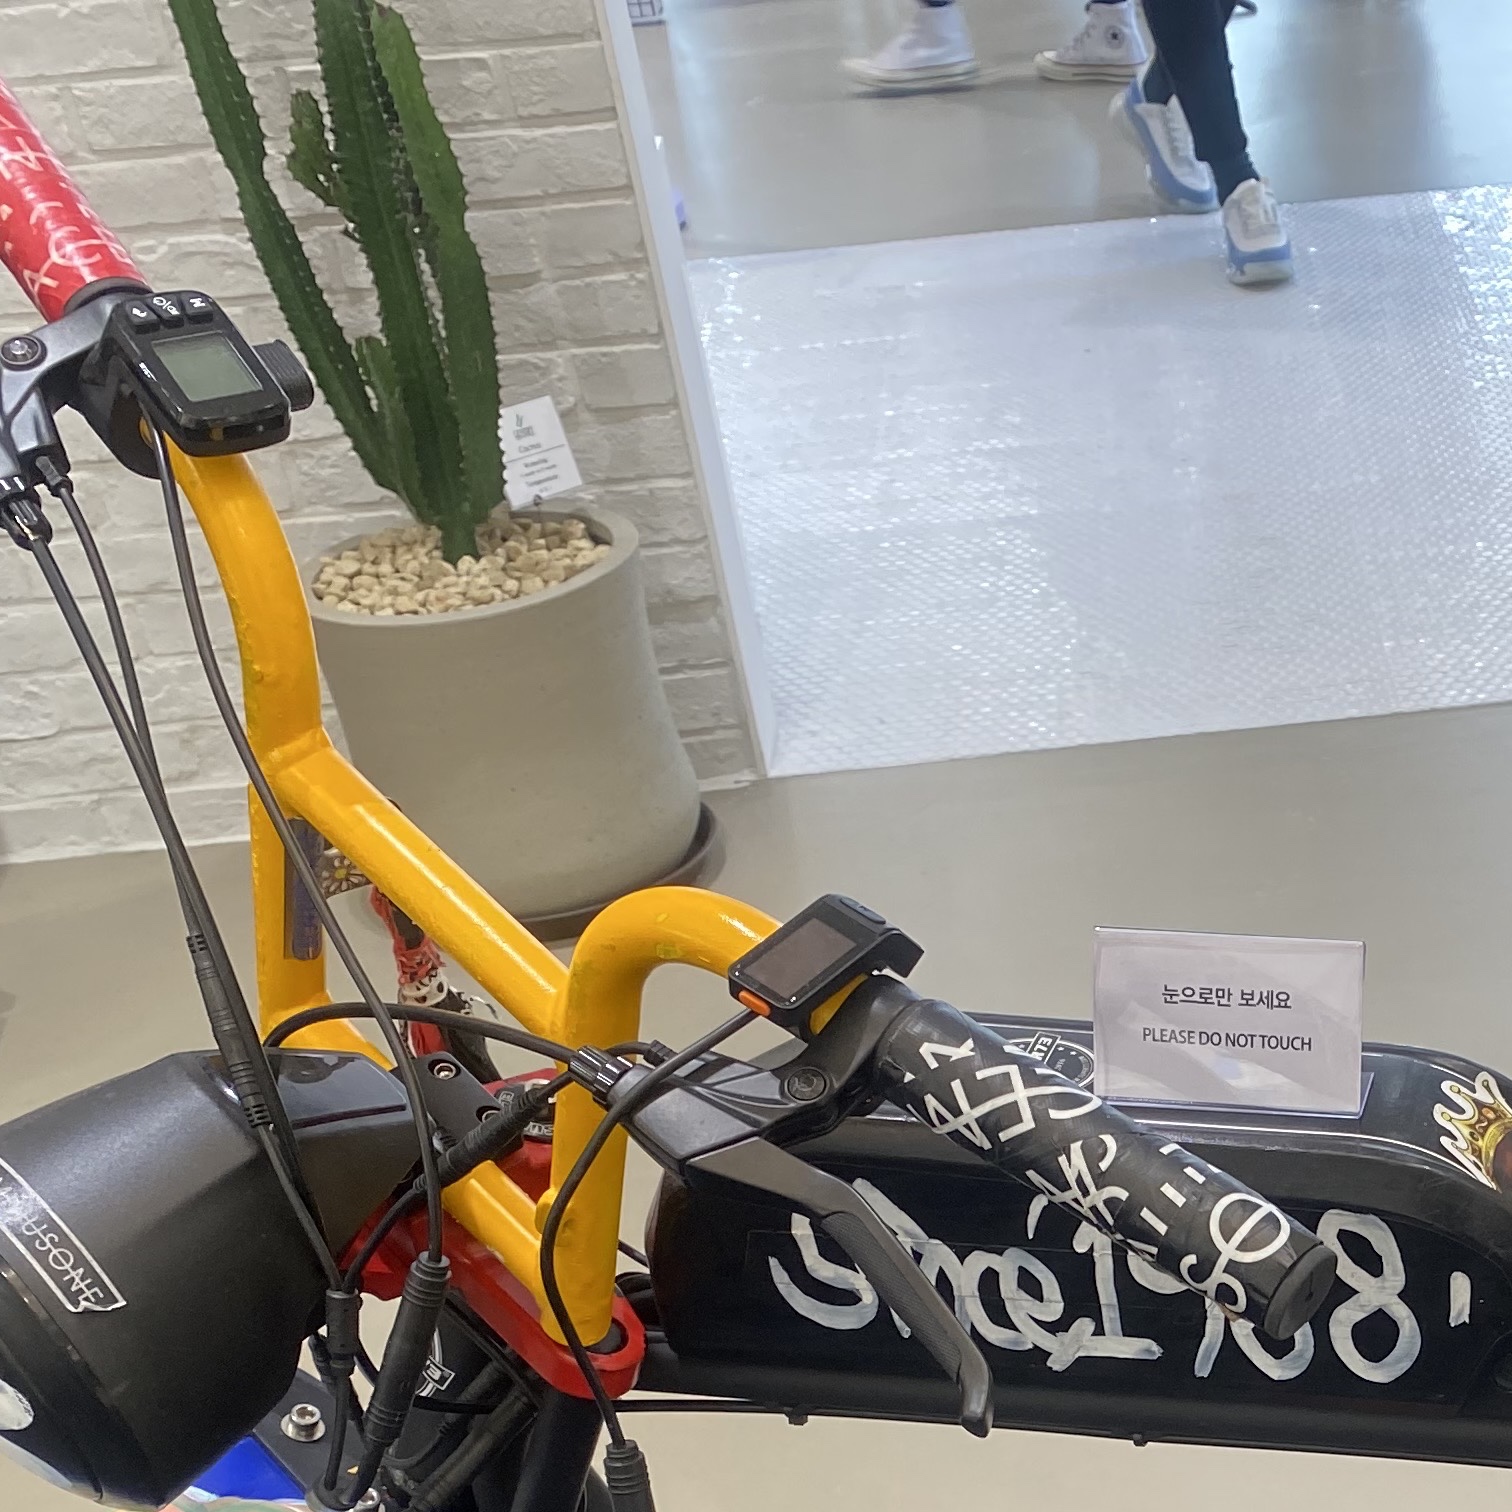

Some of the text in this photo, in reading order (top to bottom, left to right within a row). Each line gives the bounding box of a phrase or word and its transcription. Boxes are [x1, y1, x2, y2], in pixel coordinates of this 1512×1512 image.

[1162, 984, 1292, 1011] 눈으로만 보세요
[1142, 1027, 1312, 1052] PLEASE DO NOT TOUCH
